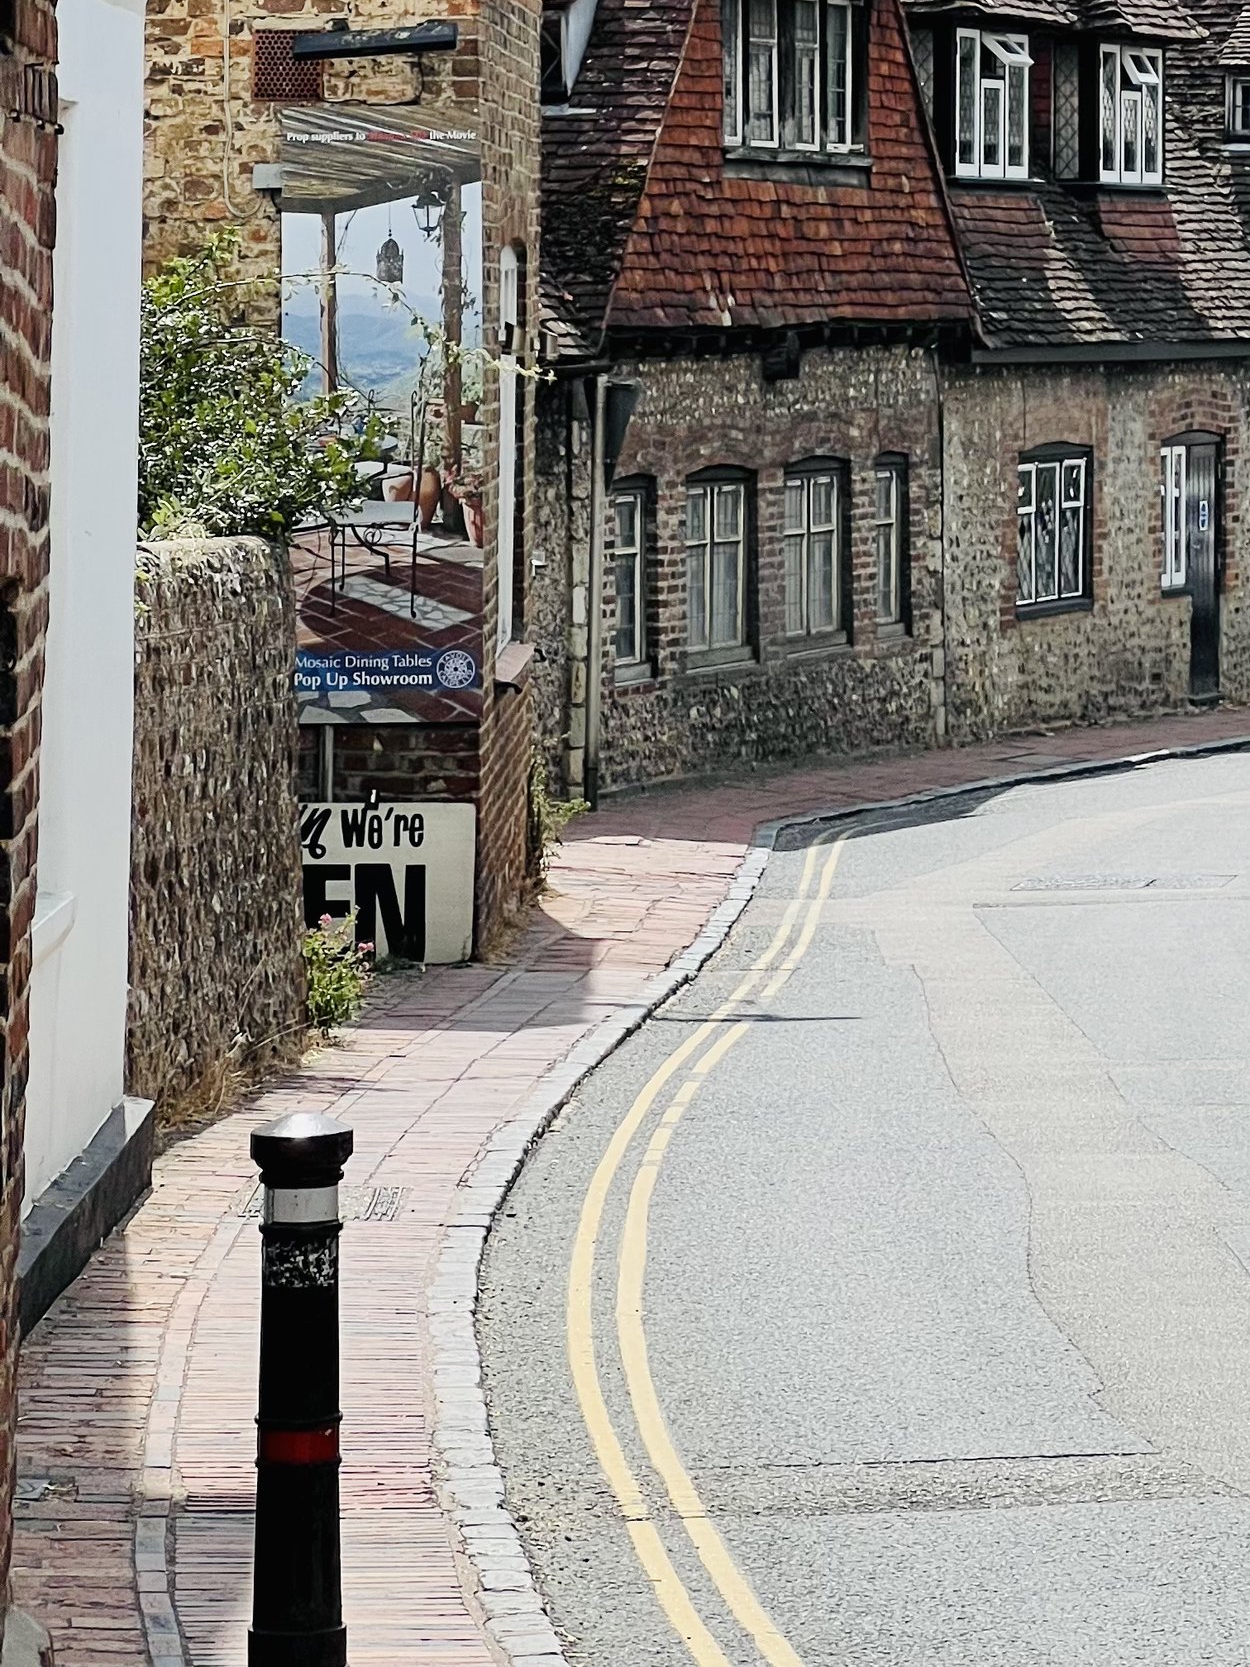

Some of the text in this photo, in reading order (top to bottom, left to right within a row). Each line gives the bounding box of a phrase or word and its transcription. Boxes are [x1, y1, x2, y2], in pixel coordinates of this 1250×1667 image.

[287, 132, 308, 144] Prop
[311, 131, 354, 143] suppliers
[355, 131, 366, 140] to
[429, 130, 446, 140] the
[447, 130, 477, 140] Movie
[295, 654, 432, 671] Mosaic Dining Tables
[294, 671, 433, 690] Pop Up Showroom
[341, 806, 425, 849] We're
[302, 864, 427, 963] EN
